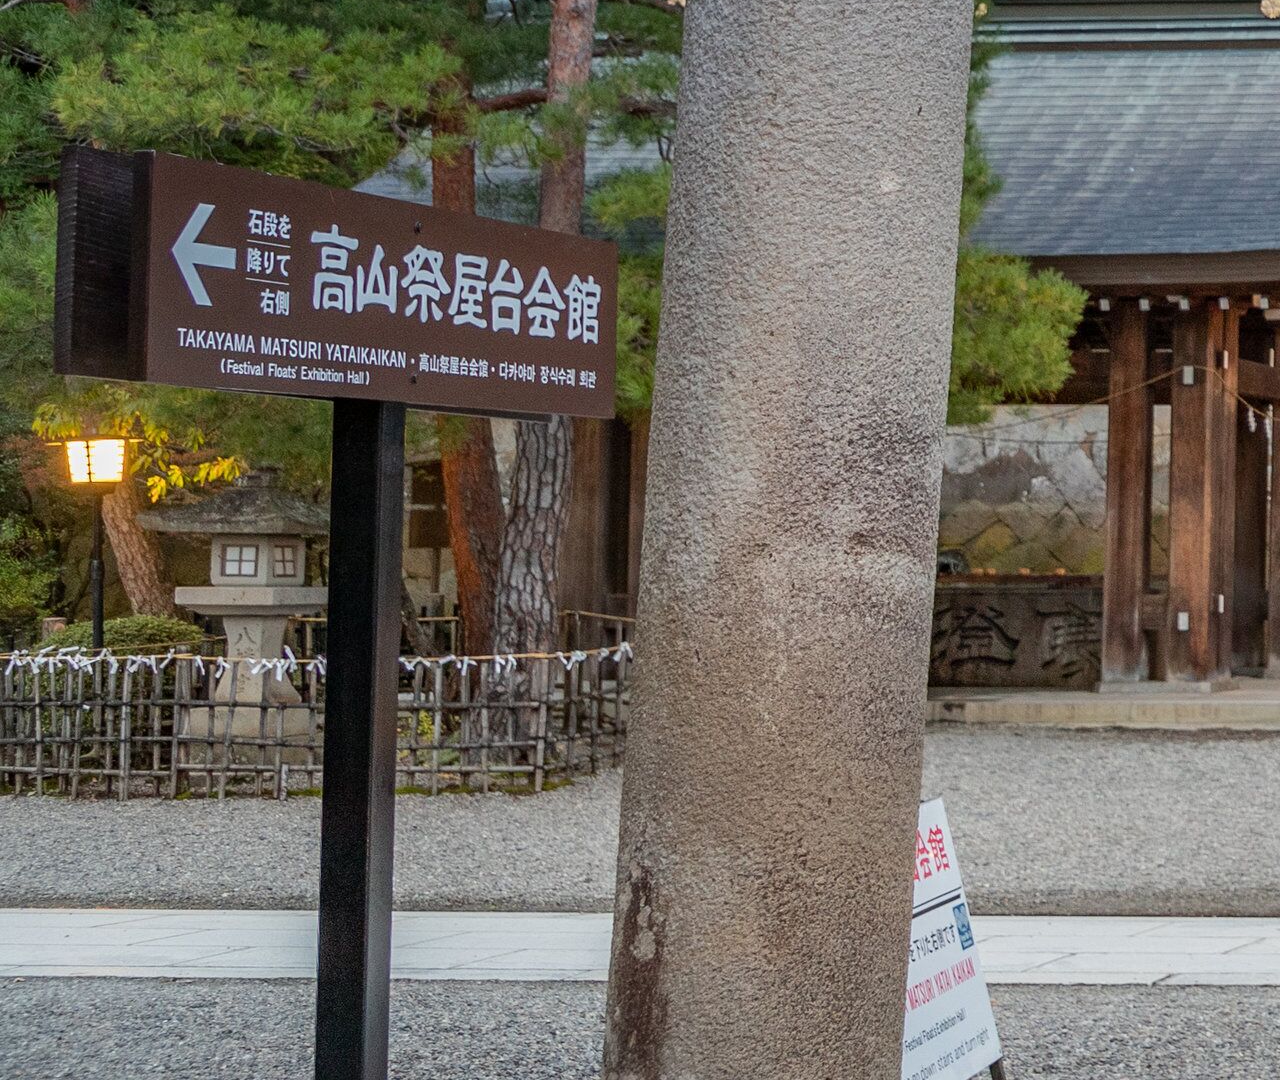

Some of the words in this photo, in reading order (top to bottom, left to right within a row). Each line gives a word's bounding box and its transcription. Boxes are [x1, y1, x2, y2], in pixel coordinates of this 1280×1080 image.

[248, 208, 292, 240] 石段を
[246, 247, 290, 278] 降りて
[310, 223, 602, 345] 高山祭屋台会館
[260, 288, 290, 316] 右側
[177, 328, 255, 354] TAKAYAMA
[260, 336, 322, 360] MATSURI
[326, 343, 406, 369] YATAIKAIKAN
[499, 361, 536, 383] 다카야마
[540, 365, 576, 388] 장식수레
[579, 370, 597, 389] 회관
[220, 357, 264, 377] (Festival
[301, 366, 345, 383] Exhibition
[347, 369, 370, 386] Hall)
[907, 977, 936, 1010] MATSURI
[933, 968, 953, 995] YATAI
[950, 956, 976, 985] KAIKAN
